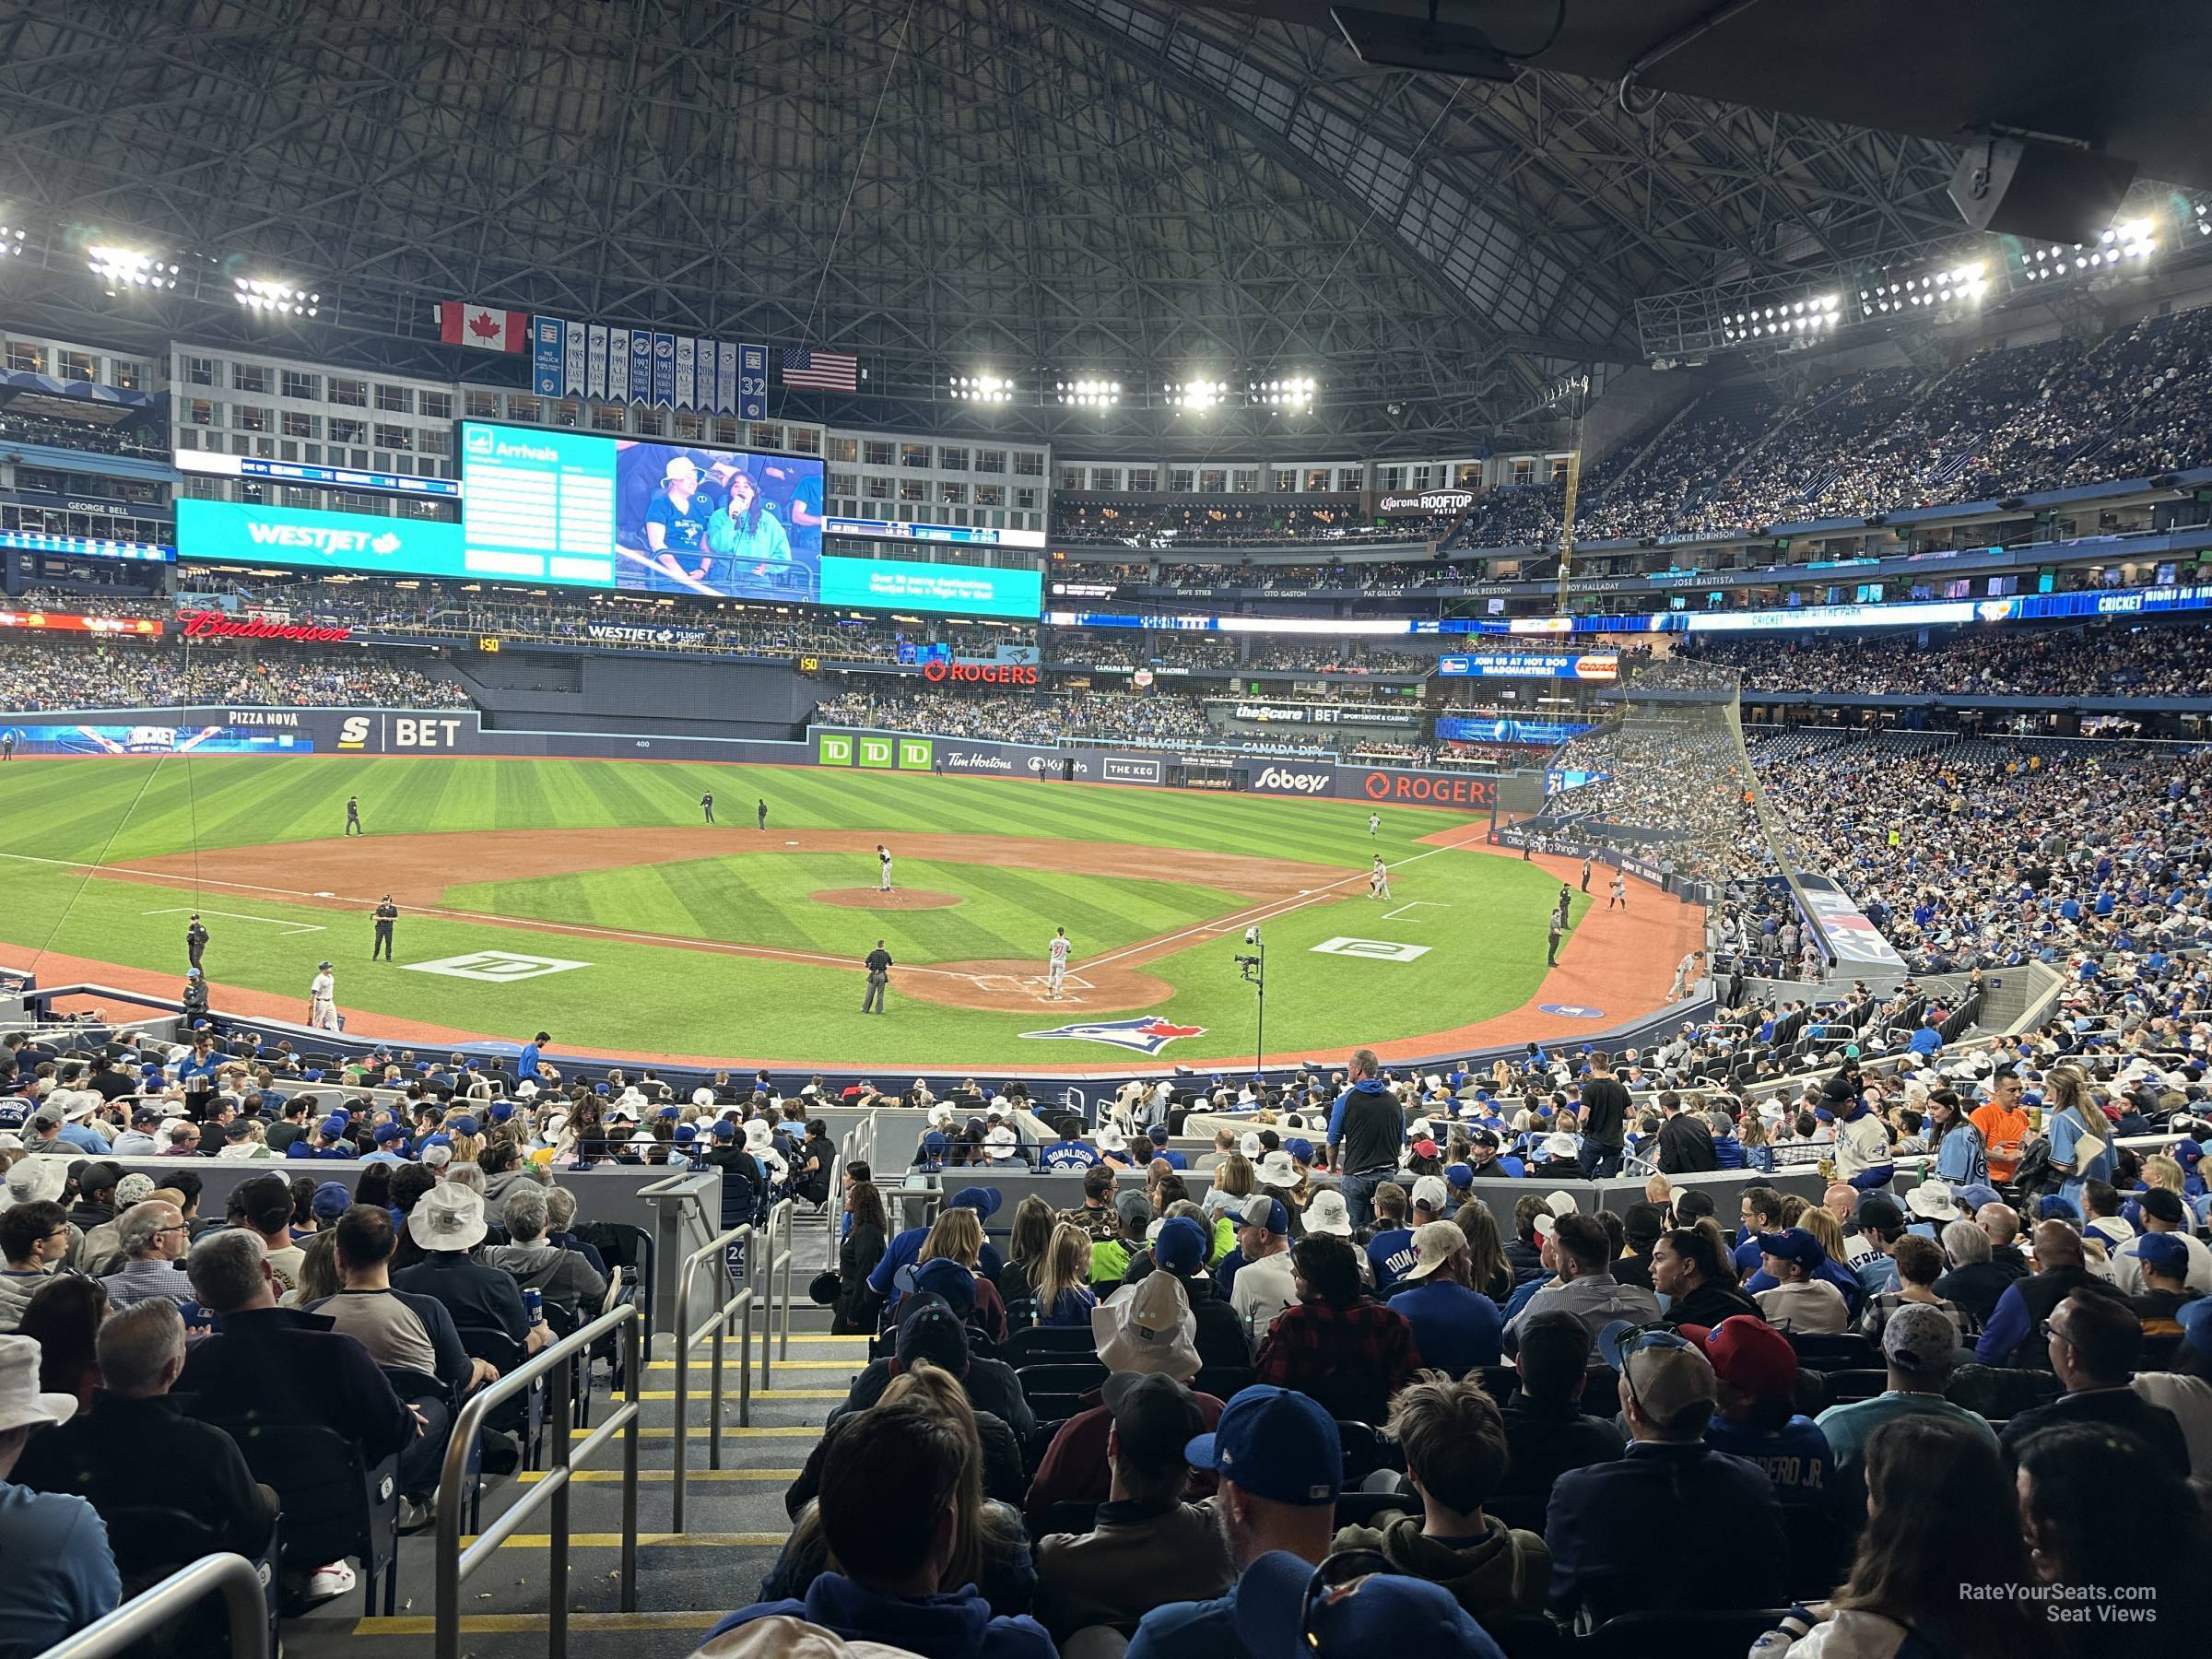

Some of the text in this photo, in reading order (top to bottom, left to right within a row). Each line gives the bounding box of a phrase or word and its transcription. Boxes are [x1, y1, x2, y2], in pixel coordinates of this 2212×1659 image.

[568, 348, 583, 360] 1985
[590, 352, 605, 363] 1989
[611, 355, 627, 367] 1991
[633, 358, 649, 370] 1992
[656, 360, 672, 371] 1993
[677, 363, 693, 374] 2015
[699, 366, 714, 376] 2016
[568, 371, 582, 379] EAST
[590, 373, 604, 382] EAST
[611, 376, 626, 384] EAST
[740, 377, 765, 395] 32
[496, 442, 559, 462] Arrivals
[67, 501, 129, 515] GEORGE BELL
[1380, 495, 1473, 511] Corona ROOFTOP
[247, 522, 371, 555] WESTJET
[1668, 534, 1694, 544] JACKIE
[1695, 531, 1735, 542] ROBINSON
[1583, 582, 1620, 591] HALLADAY
[1673, 576, 1735, 586] JOSE BAUTISTA
[1481, 586, 1512, 594] BEESTON
[2098, 594, 2143, 612] CRICKET
[177, 609, 350, 641] Budweiser
[1752, 614, 1784, 626] CRICKET
[587, 625, 706, 642] WESTJET FLIGHT
[480, 639, 499, 653] 1:50
[801, 658, 818, 670] 1:50
[1475, 657, 1494, 666] JOIN
[1495, 657, 1507, 665] US
[1524, 658, 1544, 666] HOT
[1546, 658, 1568, 666] DOG
[950, 664, 1037, 684] ROGERS
[1482, 666, 1556, 676] HEADQUARTERS!
[229, 711, 299, 726] PIZZA NOVA
[1236, 705, 1303, 722] theScore
[1314, 709, 1340, 723] BET
[341, 716, 461, 747] S BET
[636, 740, 650, 748] 400
[824, 740, 849, 759] TD
[1135, 735, 1203, 751] BLEACHES
[1241, 742, 1294, 755] CANADA
[863, 742, 888, 761] TD
[902, 745, 928, 764] TD
[947, 752, 1012, 771] Tim Hortons
[1110, 765, 1153, 775] THE KEG
[1254, 766, 1330, 793] Sobeys
[1547, 779, 1562, 794] 21
[1396, 776, 1500, 805] ROGERS
[1554, 842, 1579, 856] Shingle
[1053, 945, 1064, 956] 27
[448, 955, 554, 975] TD
[1047, 1148, 1094, 1165] DONALDSON
[1385, 1248, 1418, 1274] DON
[1802, 1457, 1824, 1490] JR.
